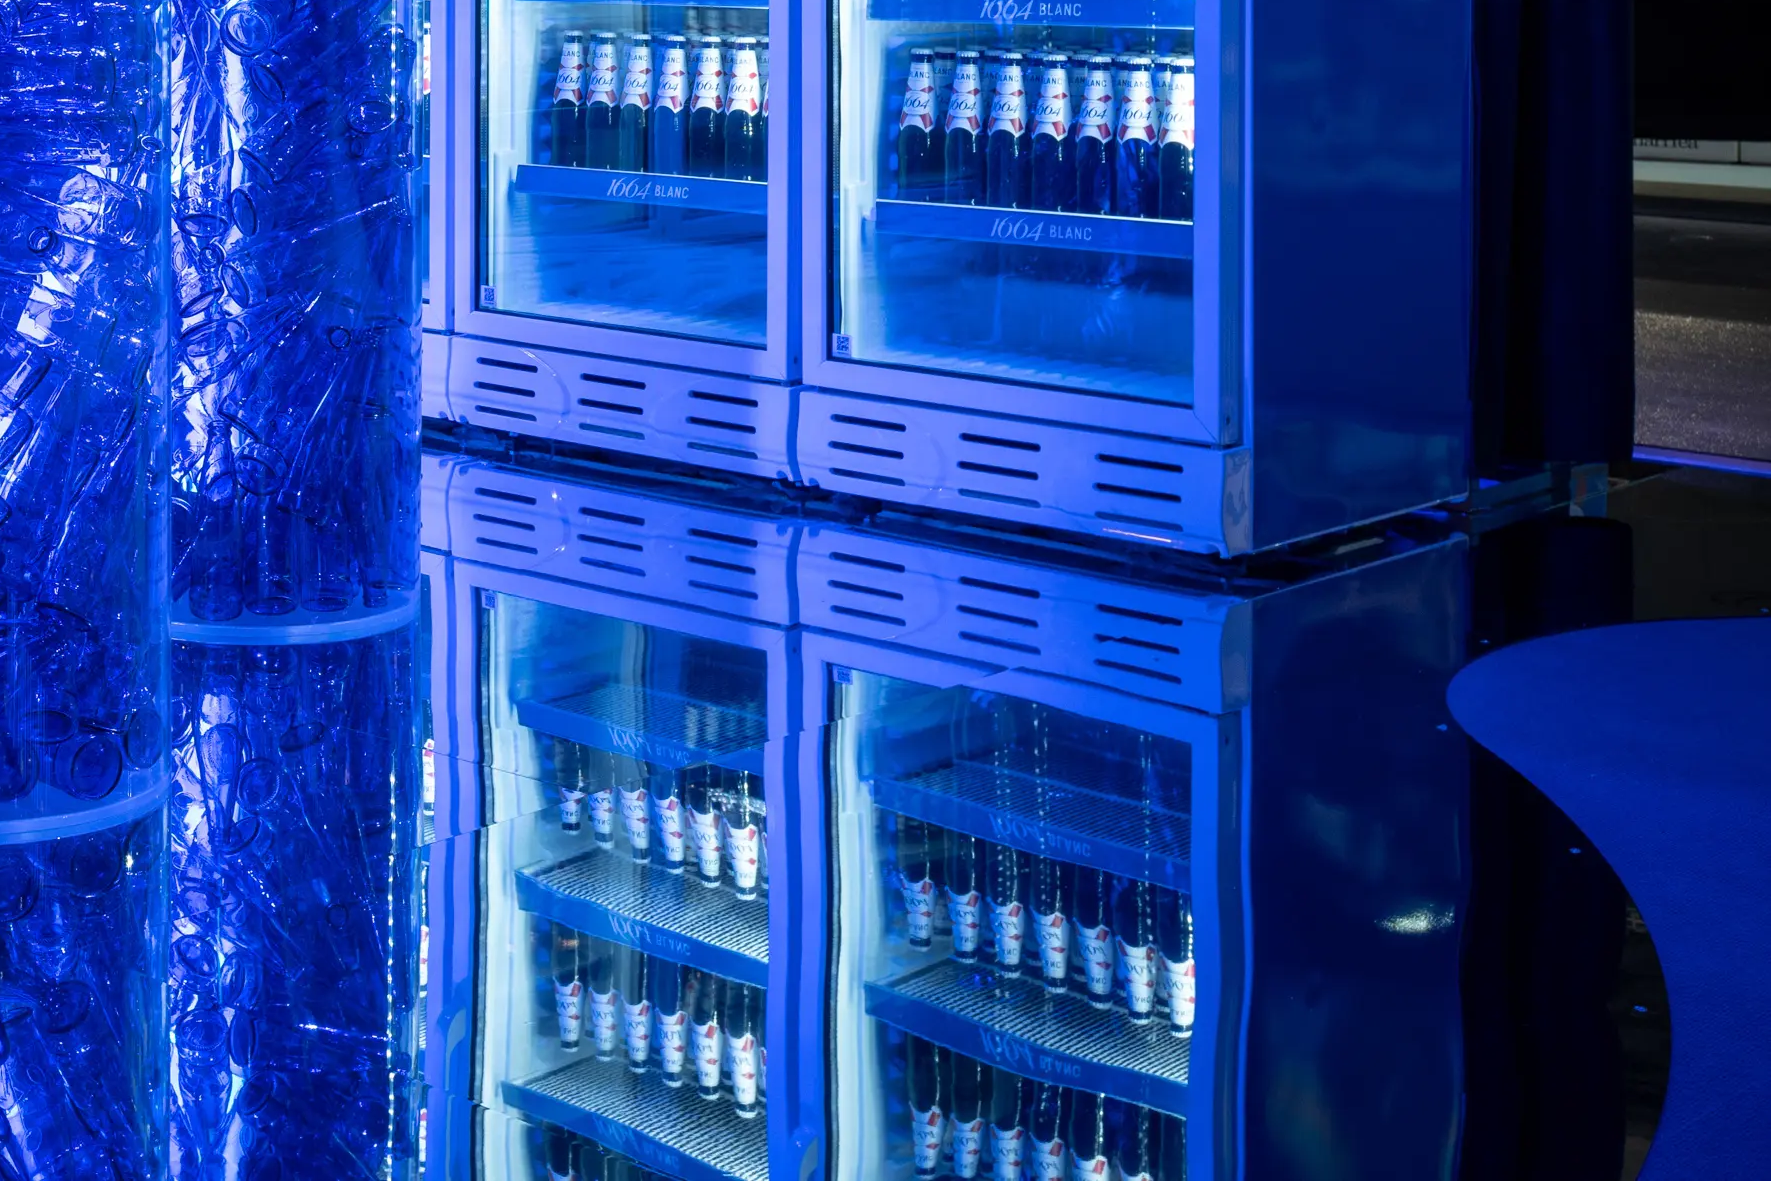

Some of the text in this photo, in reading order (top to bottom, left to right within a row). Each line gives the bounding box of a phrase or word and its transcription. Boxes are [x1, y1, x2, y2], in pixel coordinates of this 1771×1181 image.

[1039, 3, 1082, 17] BLANC
[563, 50, 581, 58] LANC
[558, 75, 580, 85] 664
[906, 98, 930, 109] 664
[1083, 107, 1107, 119] 664
[607, 177, 689, 200] 1664 BLANC
[991, 218, 1092, 241] 1664 BLANC
